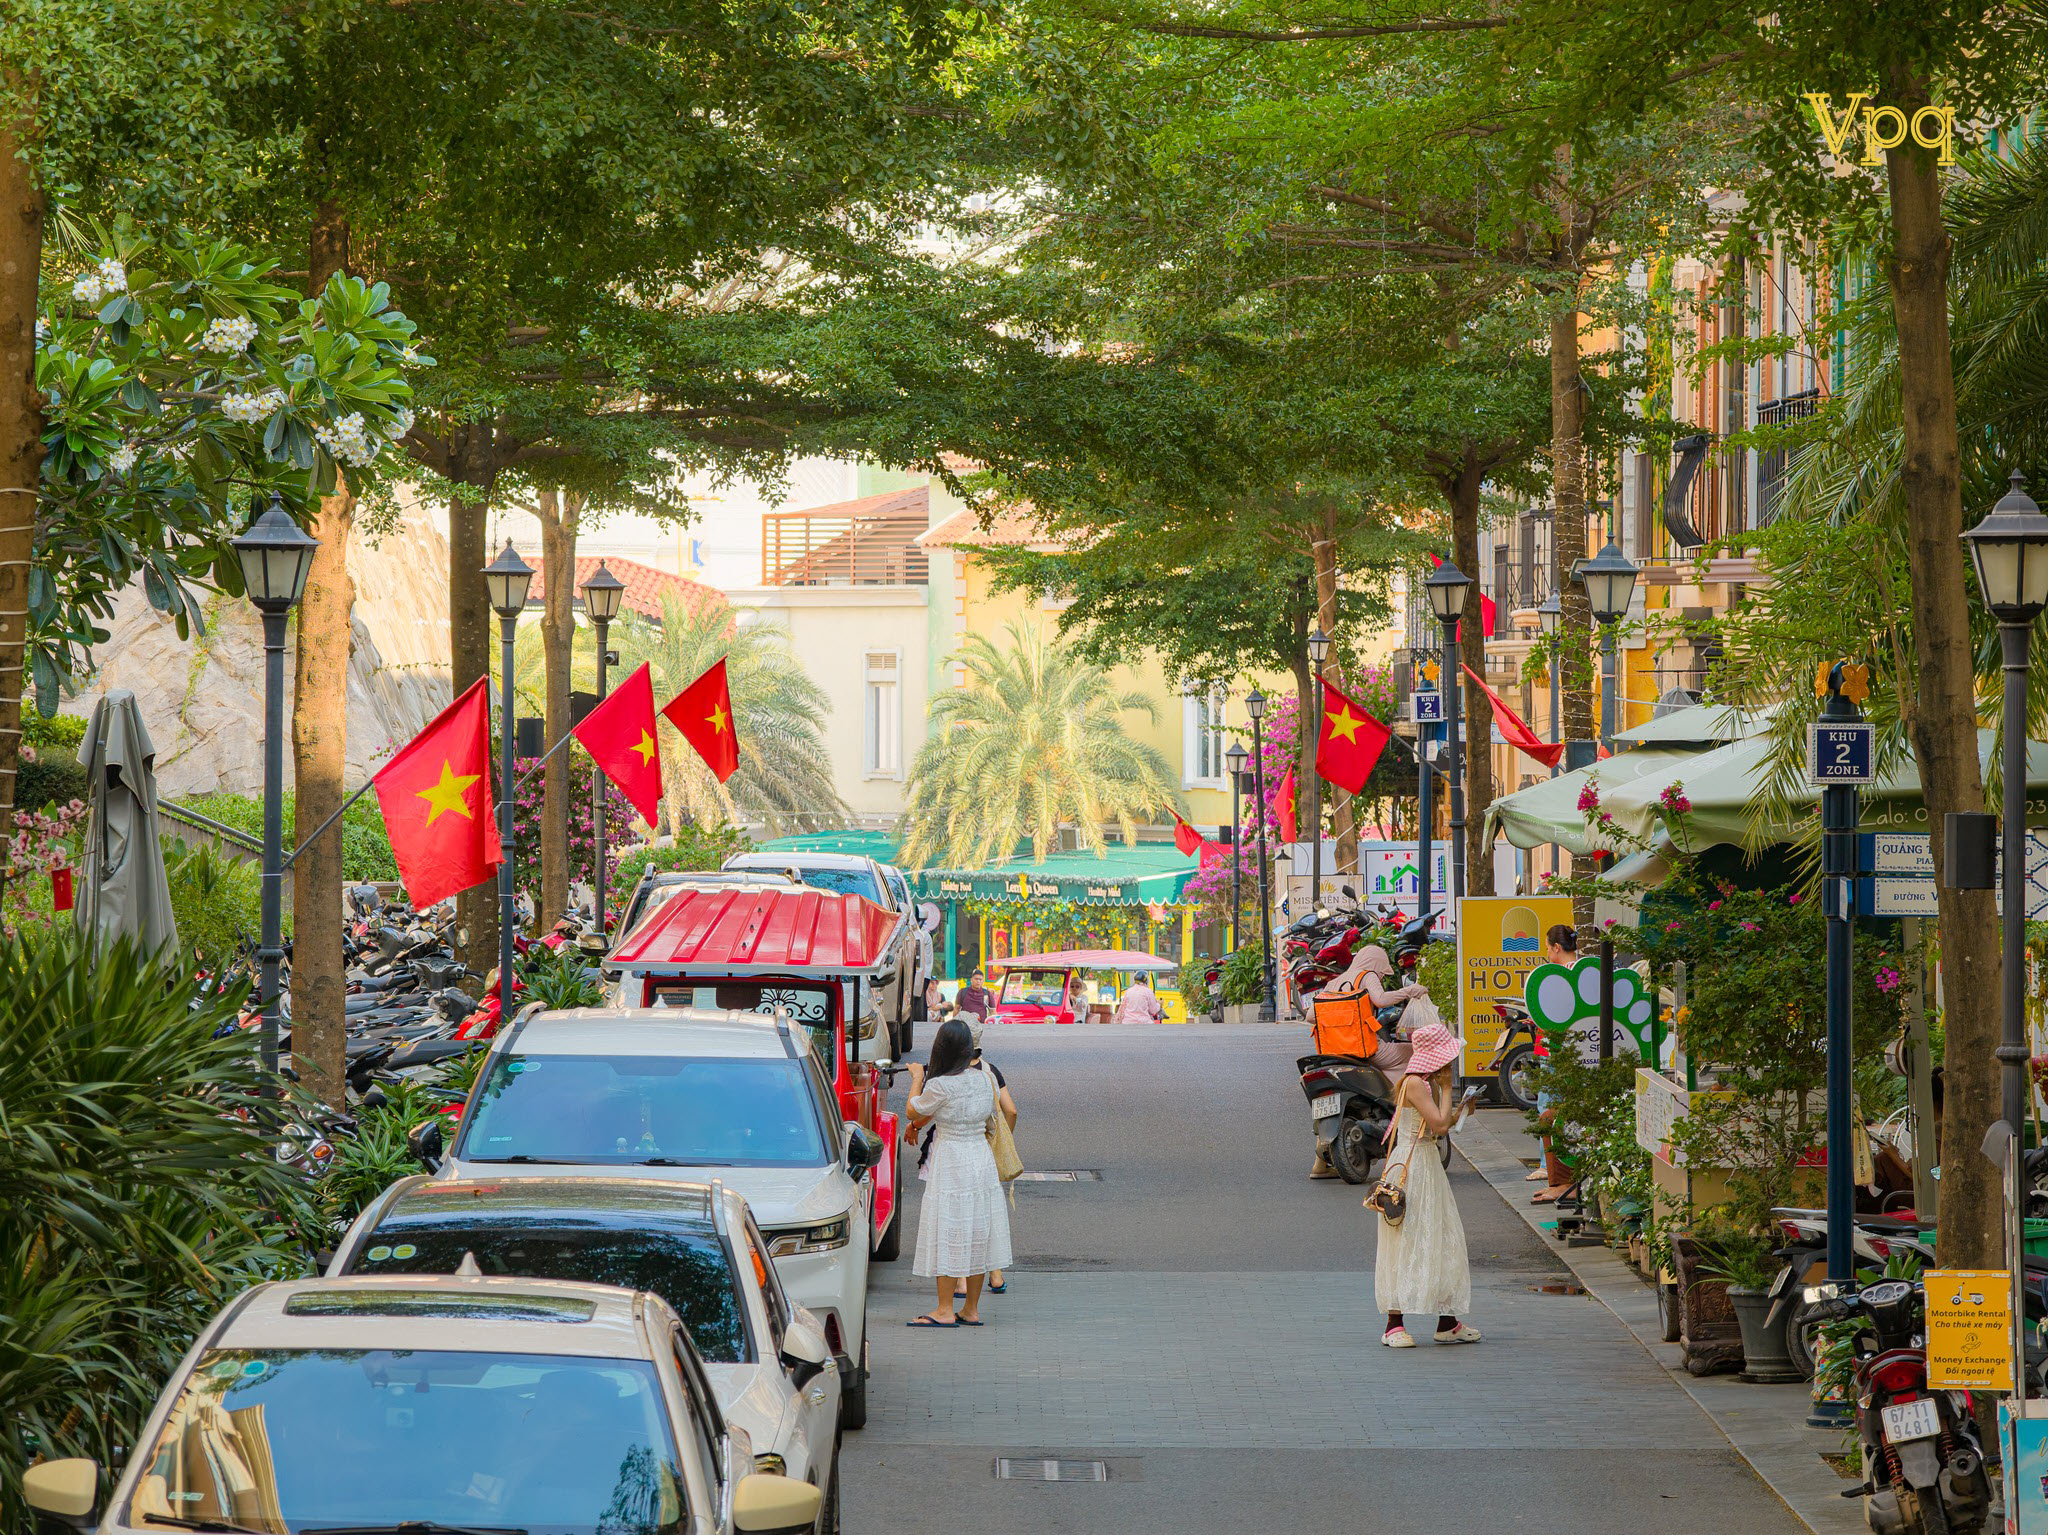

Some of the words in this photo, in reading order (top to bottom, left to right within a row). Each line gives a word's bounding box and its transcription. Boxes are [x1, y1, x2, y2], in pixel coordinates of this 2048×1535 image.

[1424, 702, 1433, 713] 2
[1829, 731, 1857, 742] KHU
[1835, 744, 1851, 764] 2
[1826, 765, 1860, 775] ZONE
[1882, 842, 1923, 854] QUẢNG
[1005, 880, 1033, 895] Lemn
[1033, 881, 1059, 896] Queen
[1893, 892, 1926, 901] ĐƯỜNG
[1468, 957, 1523, 967] GOLDEN
[1525, 956, 1551, 967] SUN
[1470, 969, 1531, 991] HOT
[1470, 1014, 1491, 1024] CHO
[1931, 1310, 1976, 1318] Motorbike
[1978, 1310, 2006, 1318] Rental
[1935, 1320, 1951, 1328] Cho
[1985, 1321, 2003, 1330] máy
[1933, 1356, 1963, 1365] Money
[1965, 1356, 2006, 1365] Exchange
[1890, 1402, 1928, 1423] 67-T1
[1893, 1418, 1932, 1439] 9481
